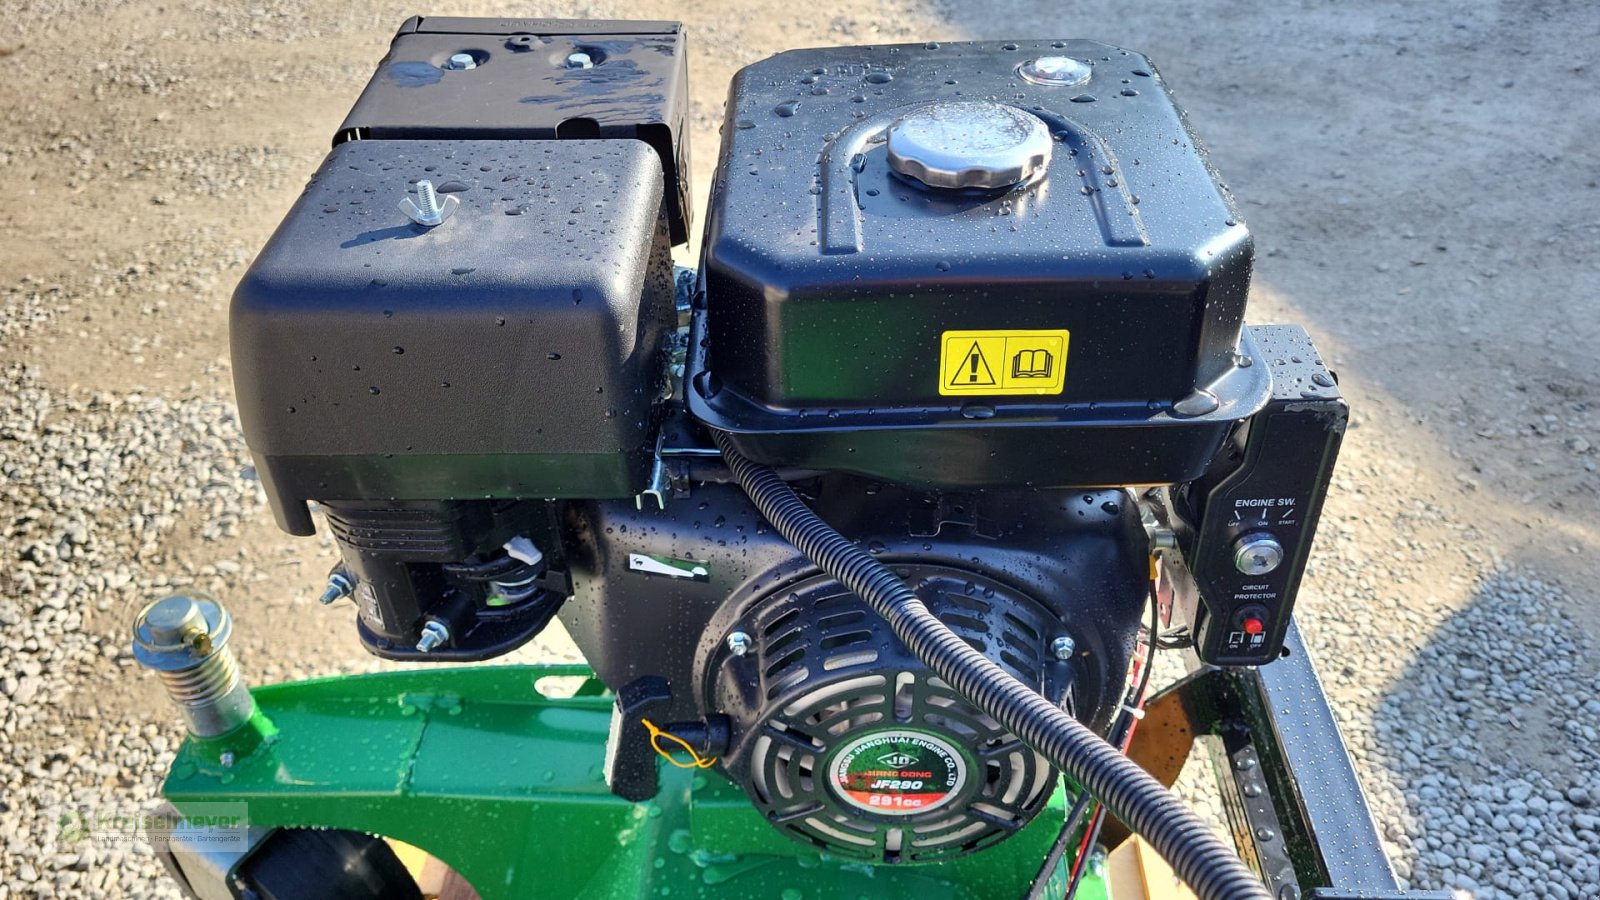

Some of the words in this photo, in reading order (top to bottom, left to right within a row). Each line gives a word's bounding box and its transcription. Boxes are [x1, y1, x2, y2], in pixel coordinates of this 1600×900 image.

[1235, 499, 1275, 507] ENGINE
[1277, 498, 1296, 506] SW.
[1234, 592, 1276, 600] PROTECTOR
[854, 736, 909, 755] JIANGHUAI
[912, 737, 947, 758] ENGINE
[887, 756, 910, 765] JD
[871, 780, 924, 790] JF290
[869, 795, 922, 807] 291cc
